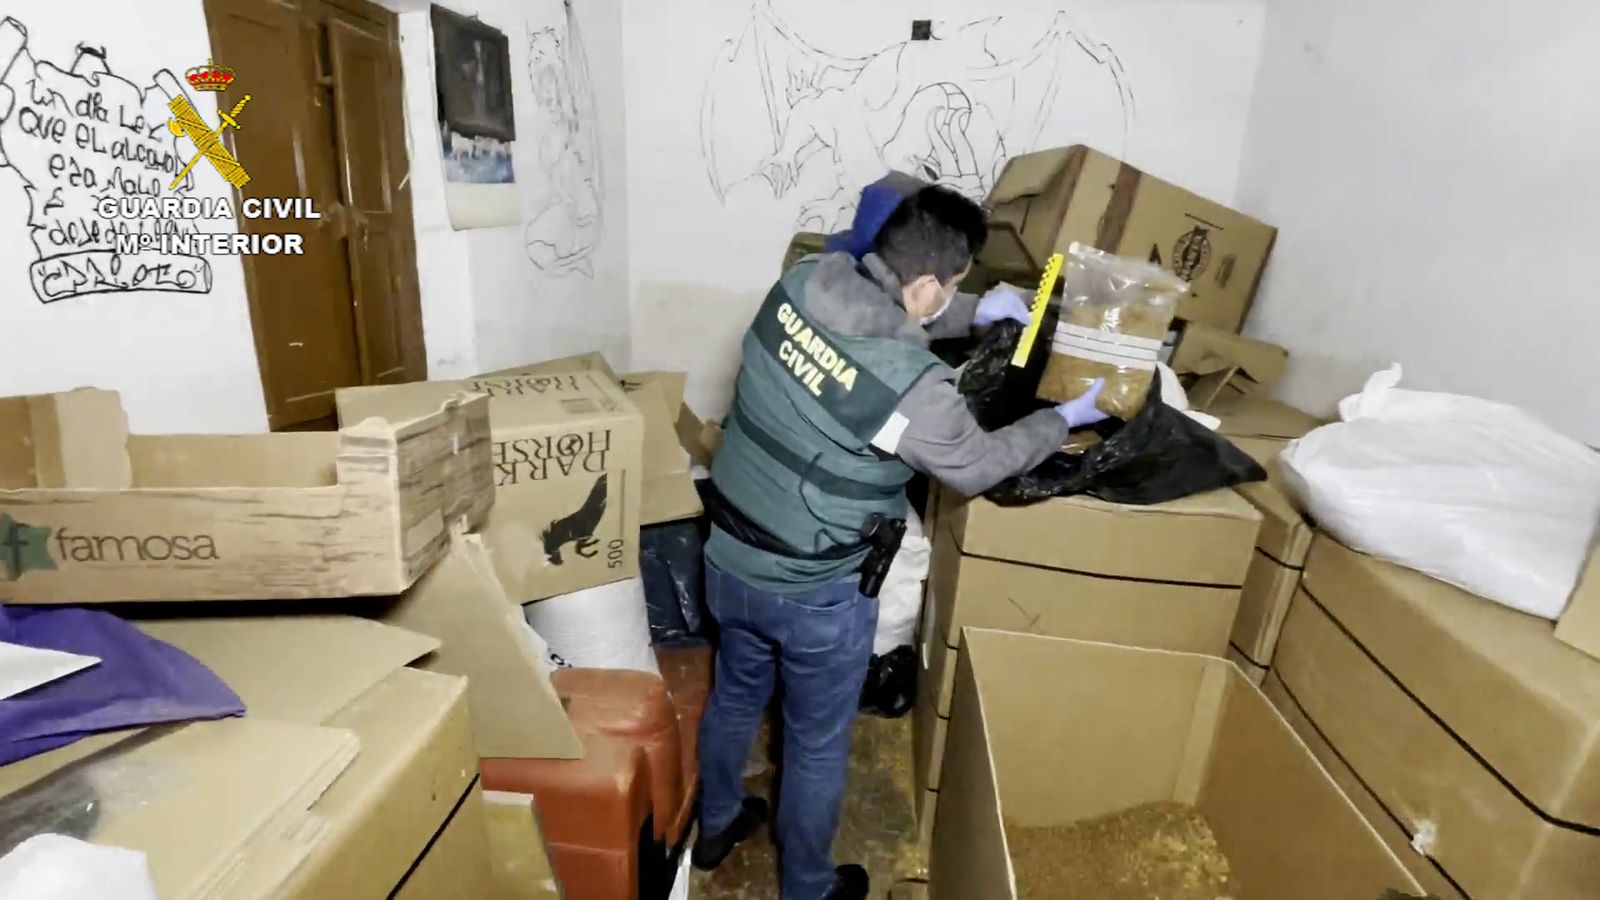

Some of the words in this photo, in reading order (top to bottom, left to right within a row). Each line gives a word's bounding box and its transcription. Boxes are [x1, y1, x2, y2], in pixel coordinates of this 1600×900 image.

[777, 302, 858, 392] GUARDIA
[779, 340, 825, 397] CIVIL
[492, 429, 612, 465] HORSE
[496, 450, 607, 487] DARK
[56, 526, 220, 561] famosa
[607, 538, 624, 569] 500
